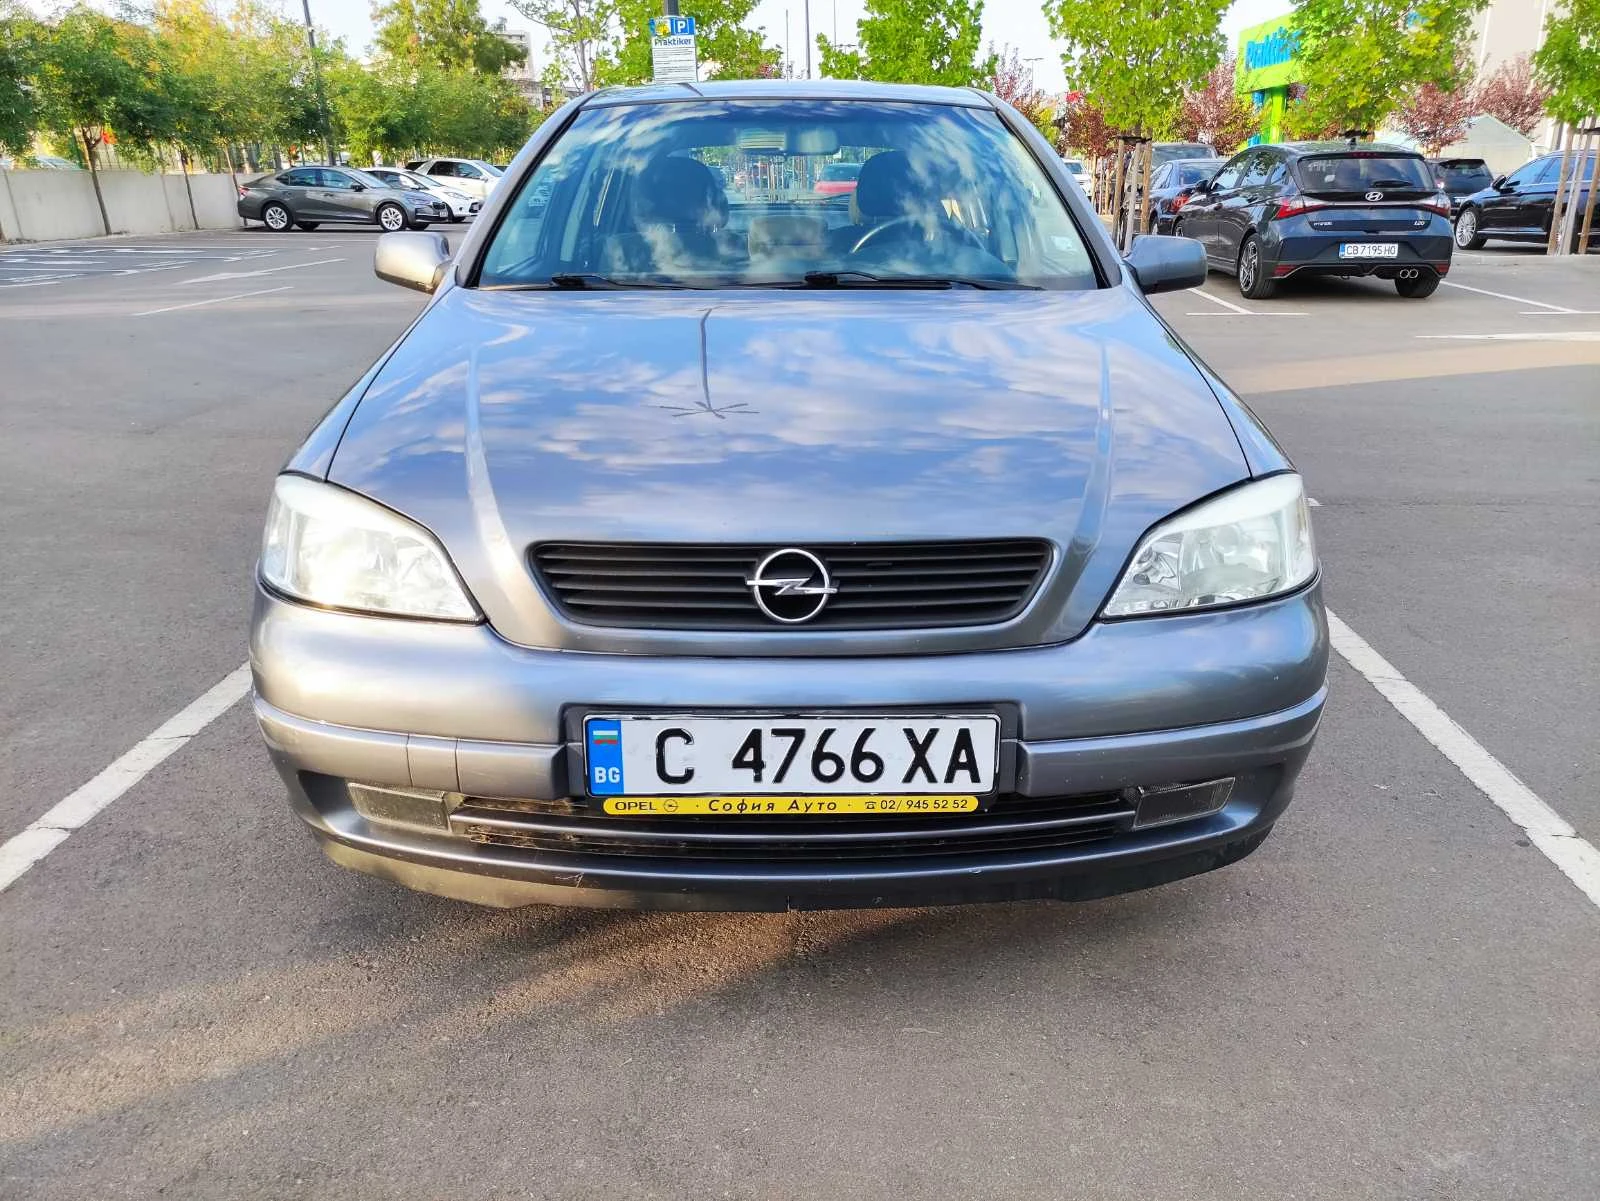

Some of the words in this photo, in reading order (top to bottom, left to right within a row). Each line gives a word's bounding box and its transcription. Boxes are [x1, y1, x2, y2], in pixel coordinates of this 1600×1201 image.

[677, 20, 686, 32] P
[654, 38, 692, 46] Praktiker
[1346, 246, 1358, 255] CB
[1360, 245, 1382, 255] 7195
[655, 727, 695, 785] C
[731, 727, 885, 784] 4766
[901, 727, 981, 784] XA
[594, 766, 620, 784] BG
[614, 801, 657, 811] OPEL
[708, 799, 775, 813] София
[787, 799, 837, 812] Ауто
[906, 799, 929, 810] 945
[933, 799, 949, 810] 52
[952, 799, 968, 810] 52
